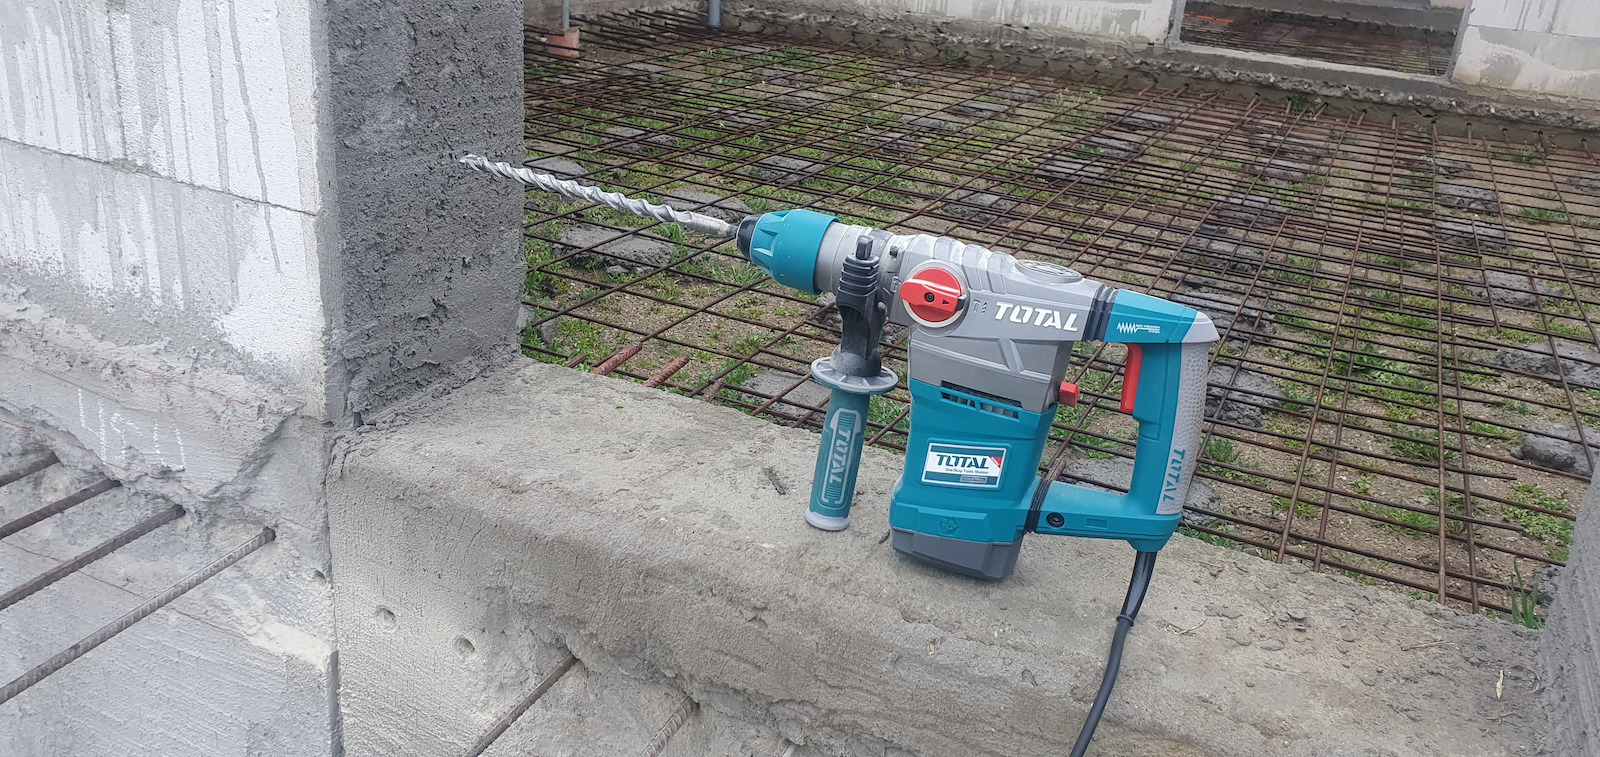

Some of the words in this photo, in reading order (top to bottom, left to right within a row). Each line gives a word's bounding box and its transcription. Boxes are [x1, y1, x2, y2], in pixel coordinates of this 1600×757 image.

[995, 301, 1079, 332] TOTAL
[829, 429, 852, 484] TOTAL
[936, 454, 990, 470] TOTAL
[1163, 449, 1186, 502] TOTAL
